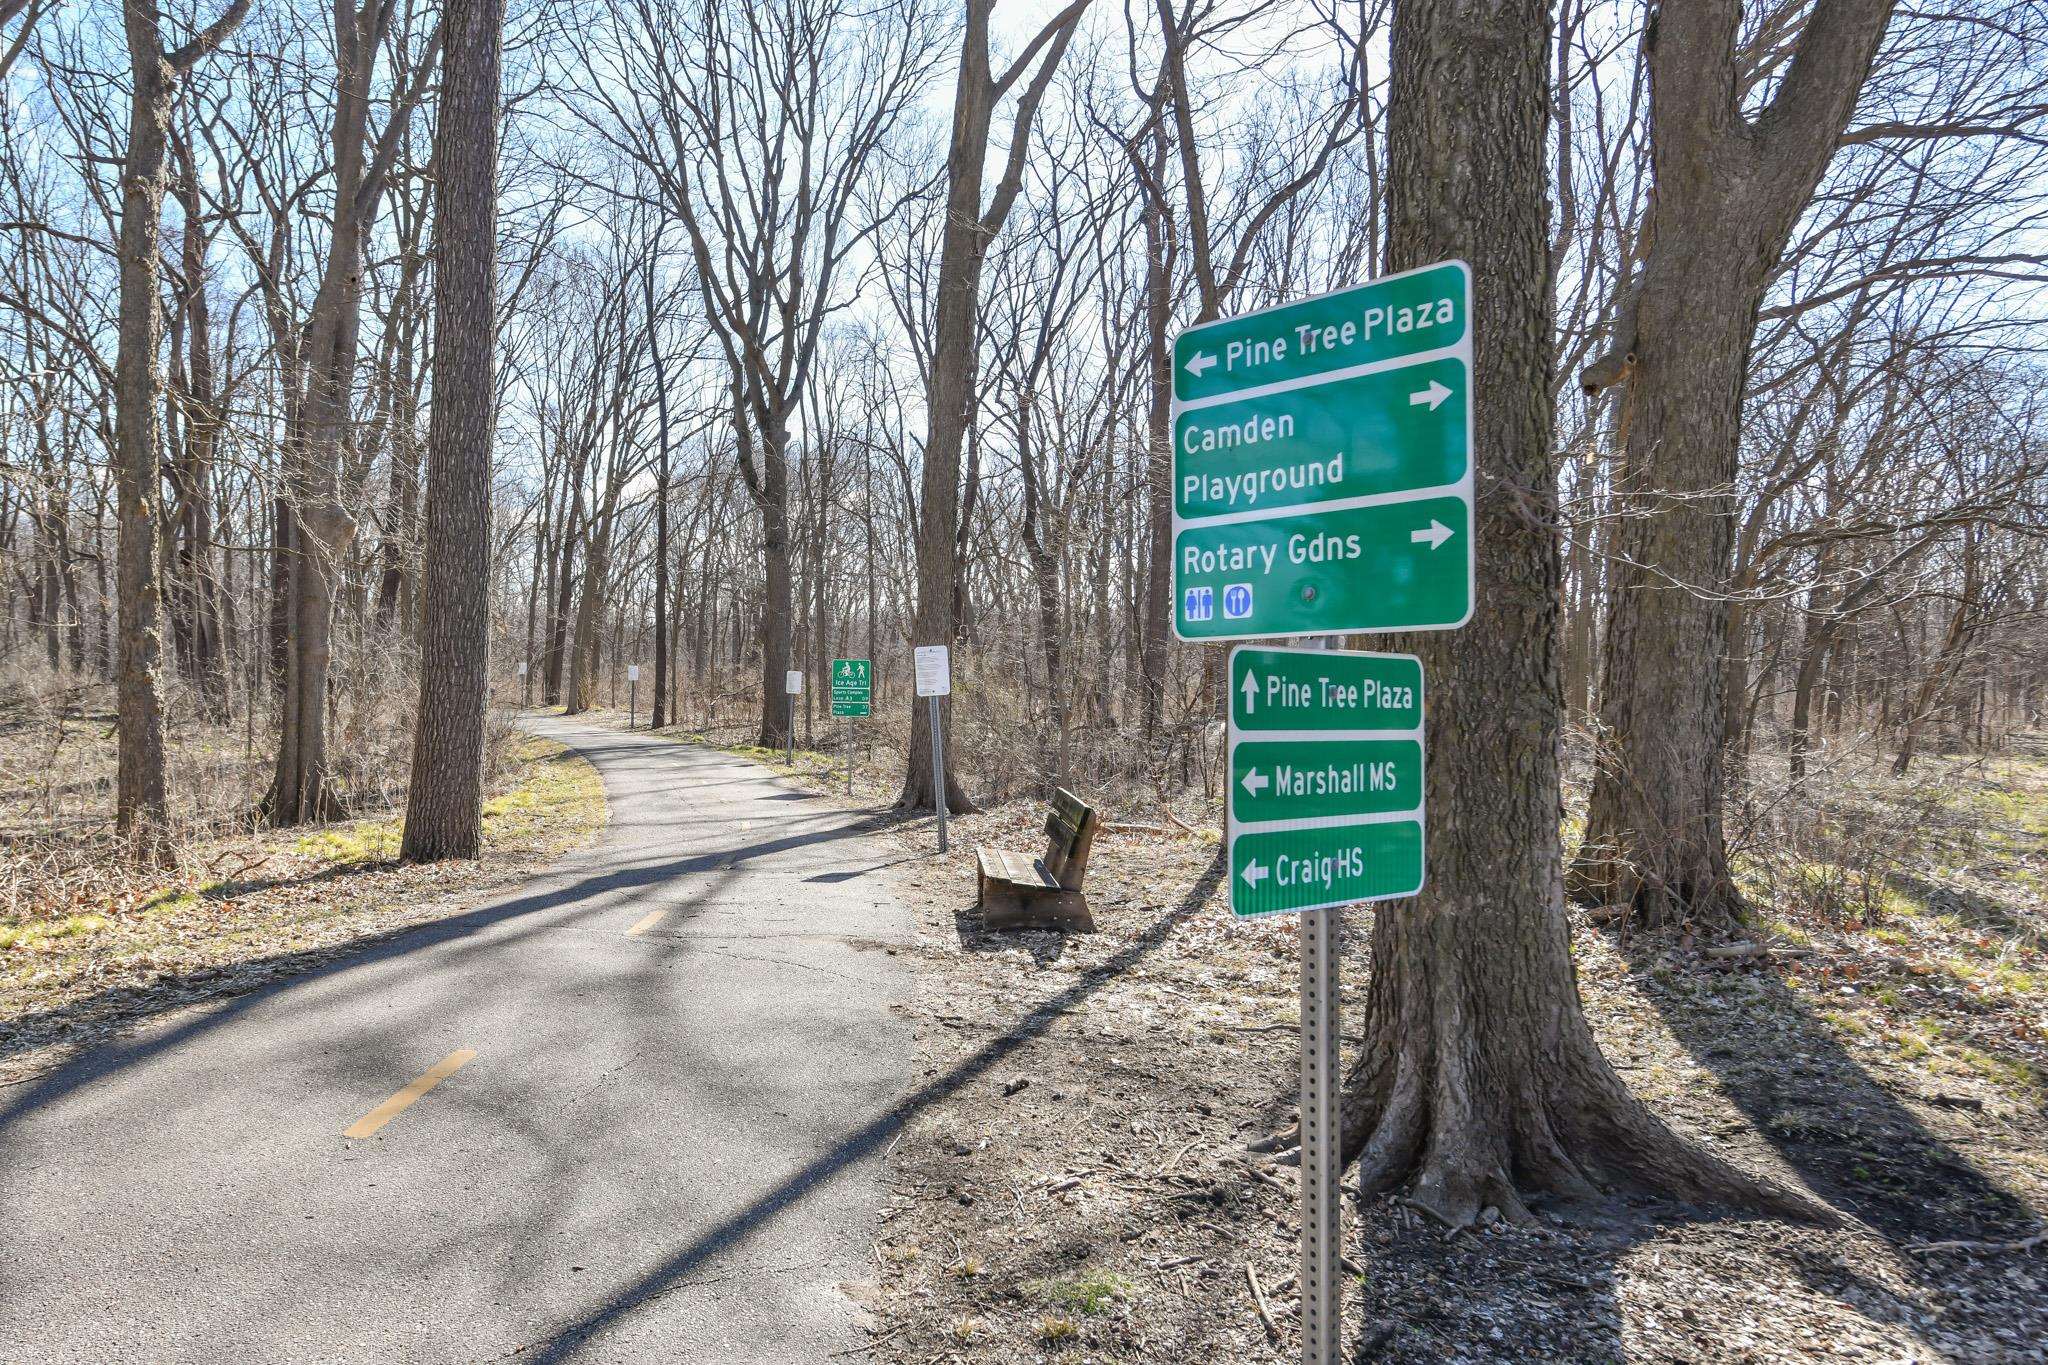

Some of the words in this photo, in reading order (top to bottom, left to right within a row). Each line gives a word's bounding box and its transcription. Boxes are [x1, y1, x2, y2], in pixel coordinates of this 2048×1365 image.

[1227, 337, 1287, 372] Pine
[1295, 320, 1357, 355] Tree
[1364, 298, 1454, 341] Plaza
[1183, 414, 1294, 455] Camden
[1183, 452, 1343, 505] Playground
[1184, 543, 1278, 575] Rotary
[1288, 532, 1361, 565] Gdns
[1266, 675, 1312, 708] Pine
[1318, 677, 1358, 709] Tree
[1363, 679, 1413, 709] Plaza
[1275, 763, 1364, 797] Marshall
[1369, 761, 1397, 792] MS
[1275, 850, 1332, 890] Craig
[1337, 846, 1364, 879] HS
